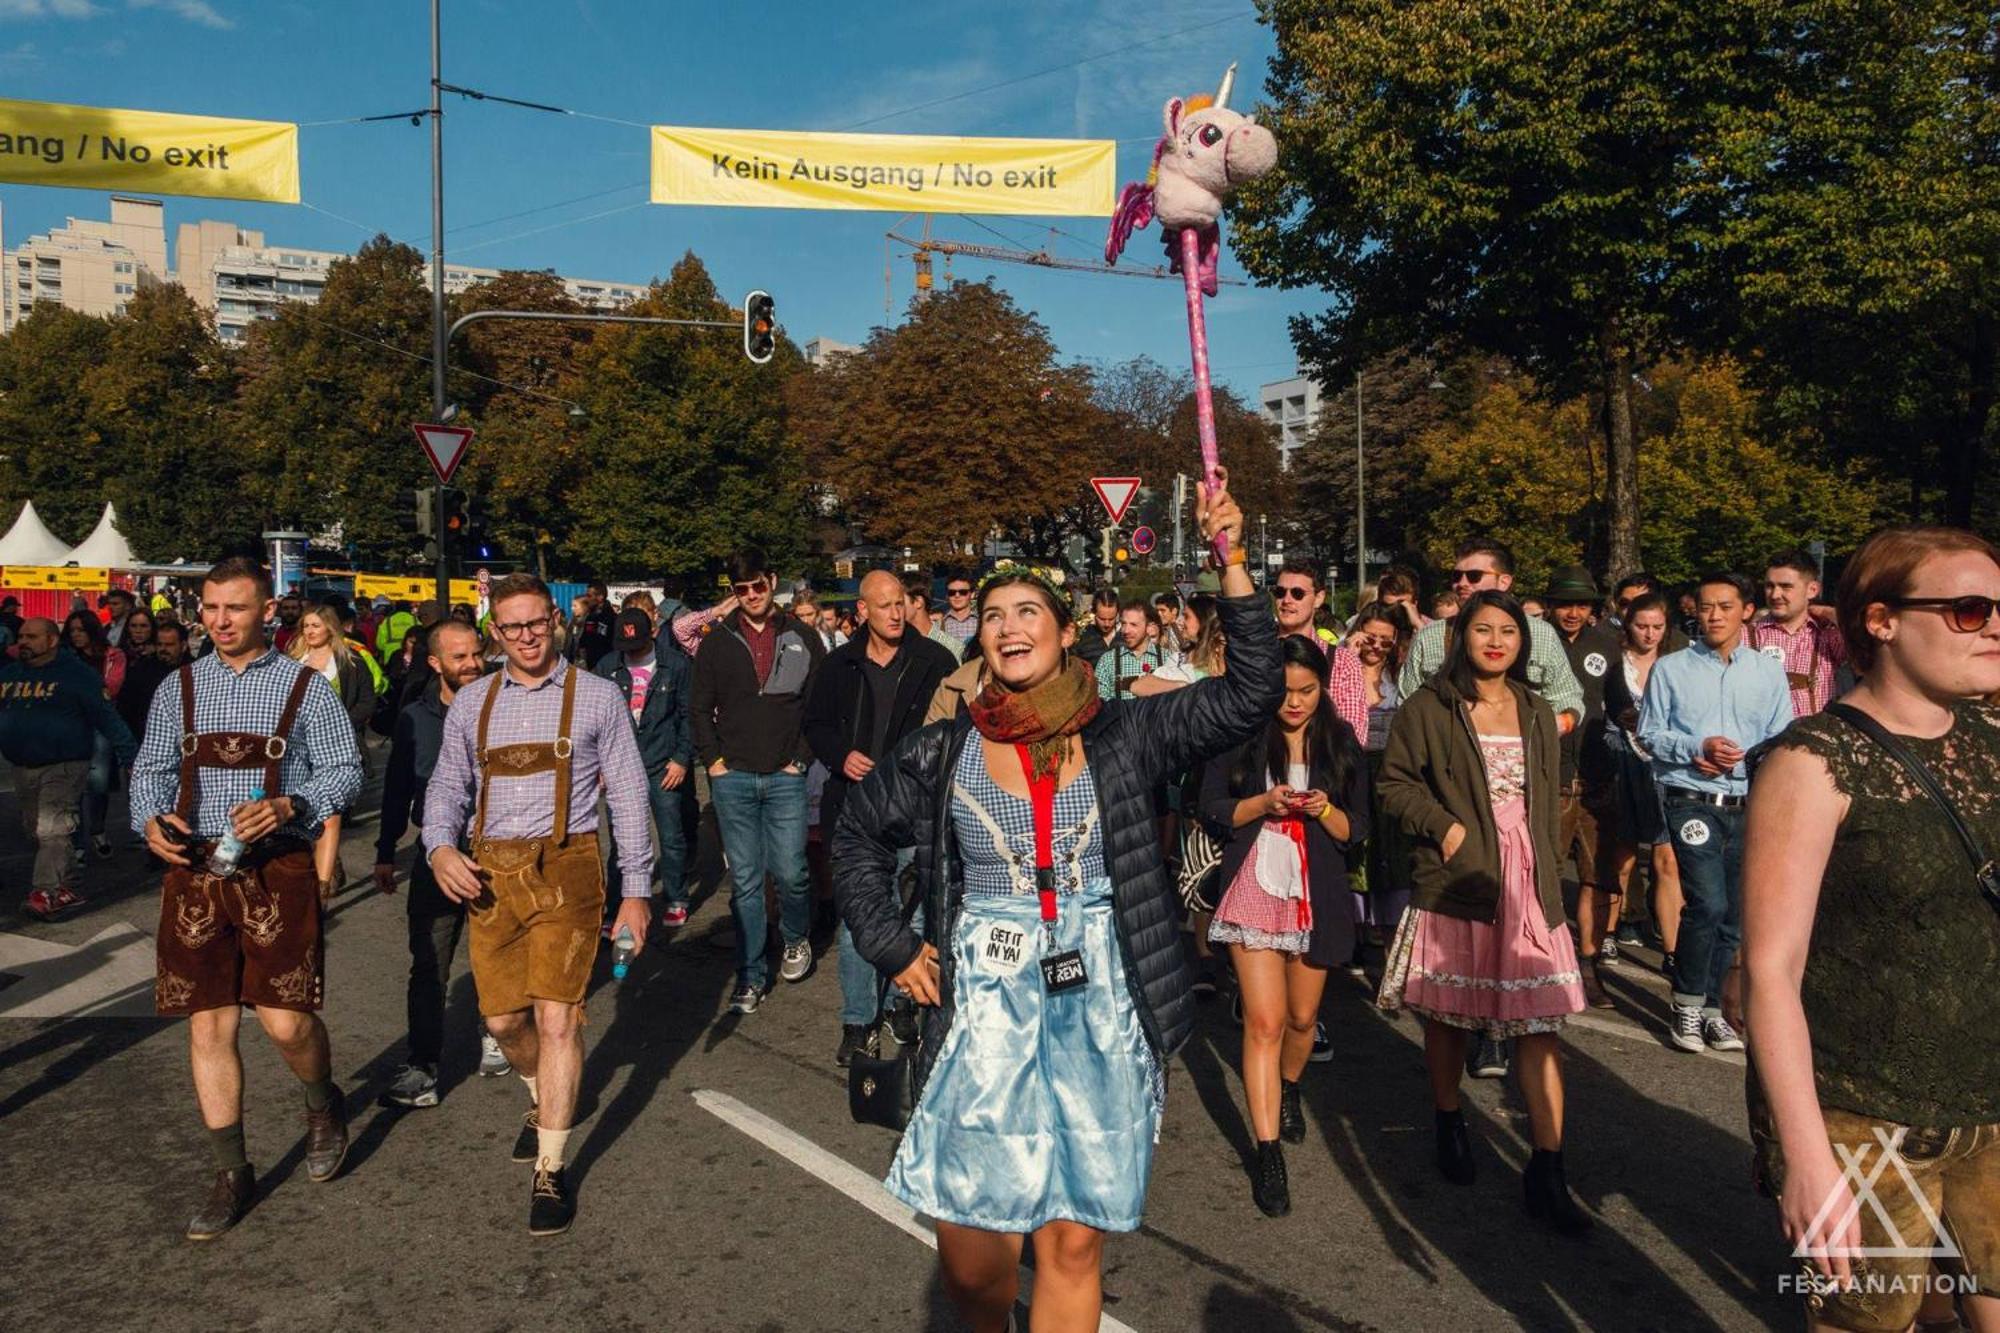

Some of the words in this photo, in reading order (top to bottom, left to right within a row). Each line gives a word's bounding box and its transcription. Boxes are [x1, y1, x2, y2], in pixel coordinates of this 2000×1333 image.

[78, 134, 88, 159] /
[102, 136, 151, 162] No
[164, 144, 229, 169] exit
[712, 153, 779, 180] Kein
[789, 158, 924, 191] Ausgang
[934, 163, 943, 187] /
[954, 163, 993, 188] No
[1003, 165, 1057, 189] exit
[991, 927, 1011, 944] GET
[1012, 932, 1024, 947] IT
[986, 943, 1000, 958] IN
[1003, 946, 1021, 962] YA!
